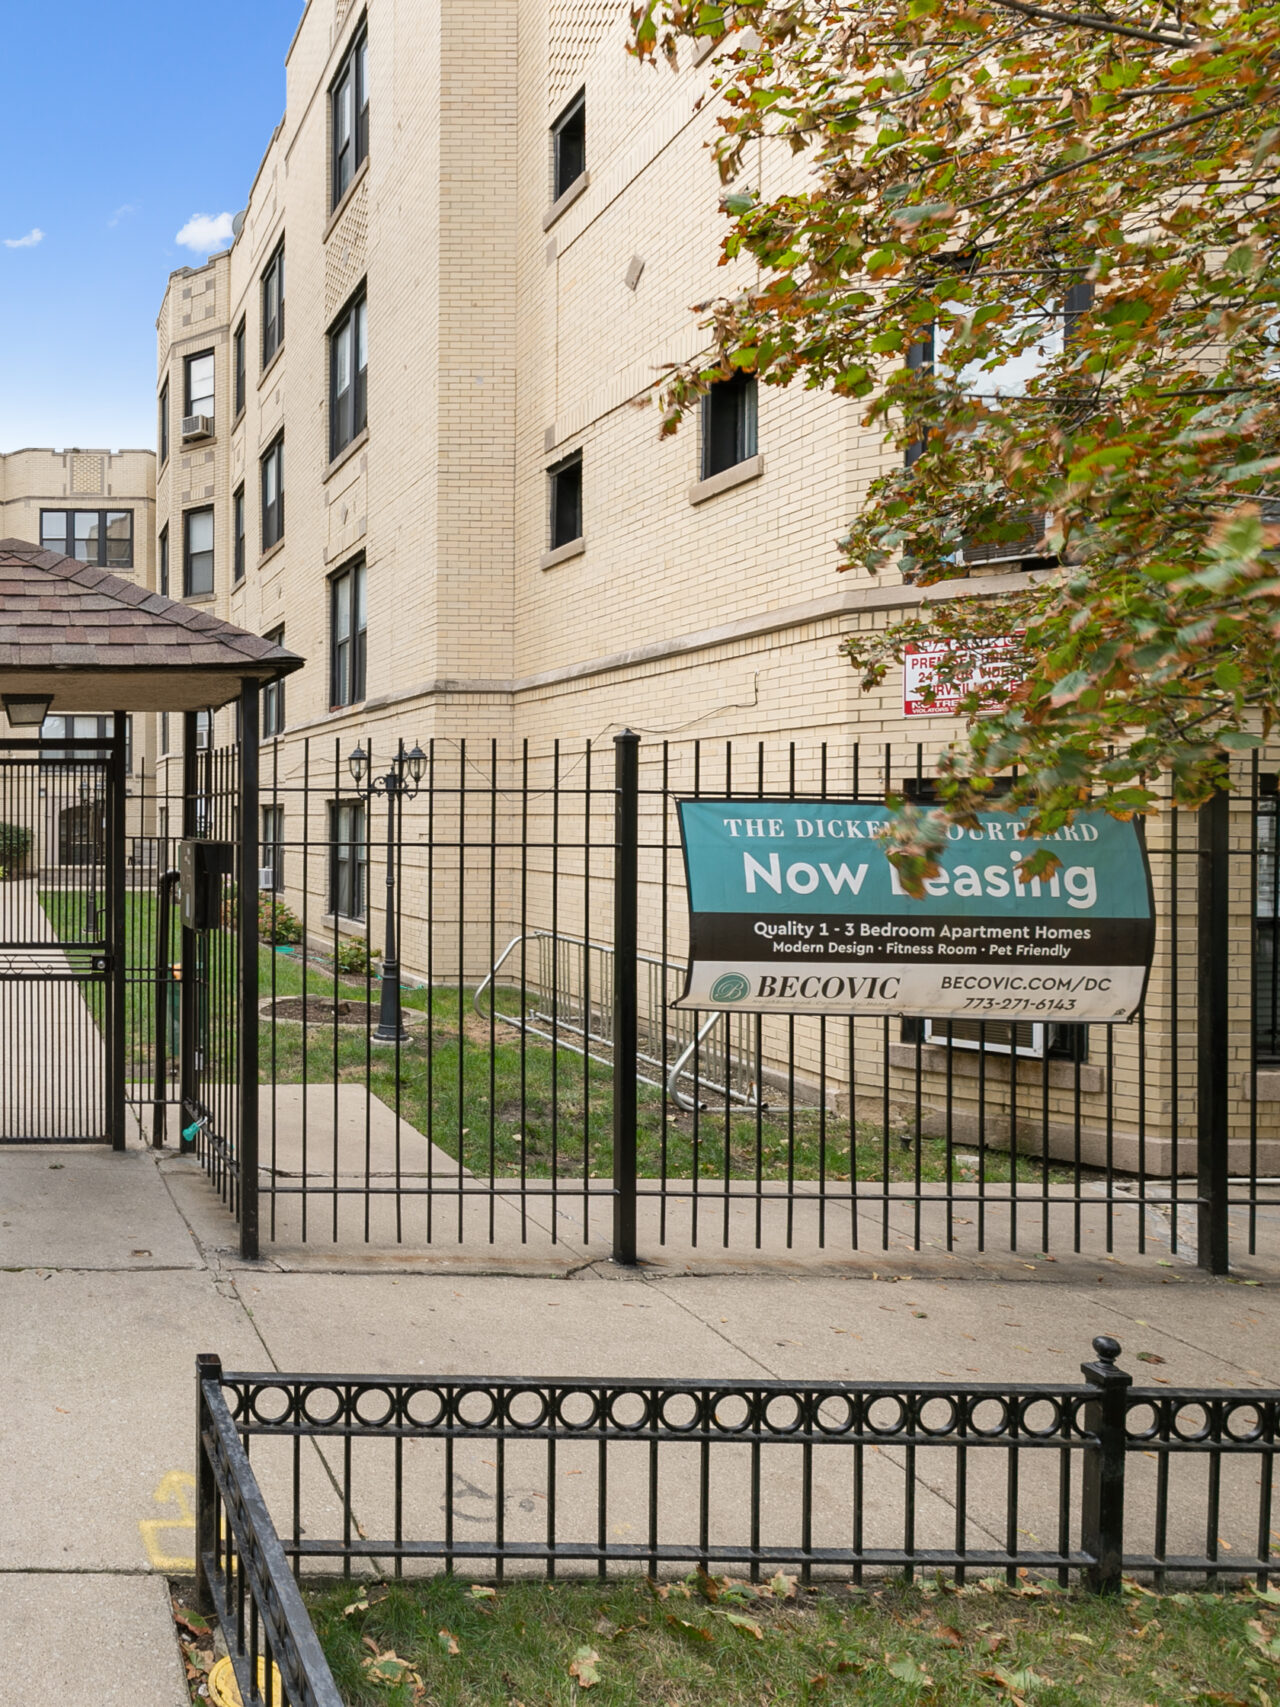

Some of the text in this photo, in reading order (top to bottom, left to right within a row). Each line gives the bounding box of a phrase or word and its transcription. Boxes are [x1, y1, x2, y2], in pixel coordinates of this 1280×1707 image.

[723, 818, 1099, 842] THE DICKE OURTARD
[743, 850, 1098, 909] Now Leasing
[753, 920, 814, 939] Quality
[819, 923, 829, 936] 1
[844, 923, 855, 936] 3
[860, 922, 936, 937] Bedroom
[939, 924, 1030, 941] Apartment
[1035, 925, 1092, 940] Homes
[773, 940, 1071, 959] Modern Design Fitness Room Pet Friendly
[755, 975, 901, 1000] BECOVIC
[941, 975, 1112, 993] BECOVIC.COM/DC
[962, 997, 1077, 1011] 773-271-6143
